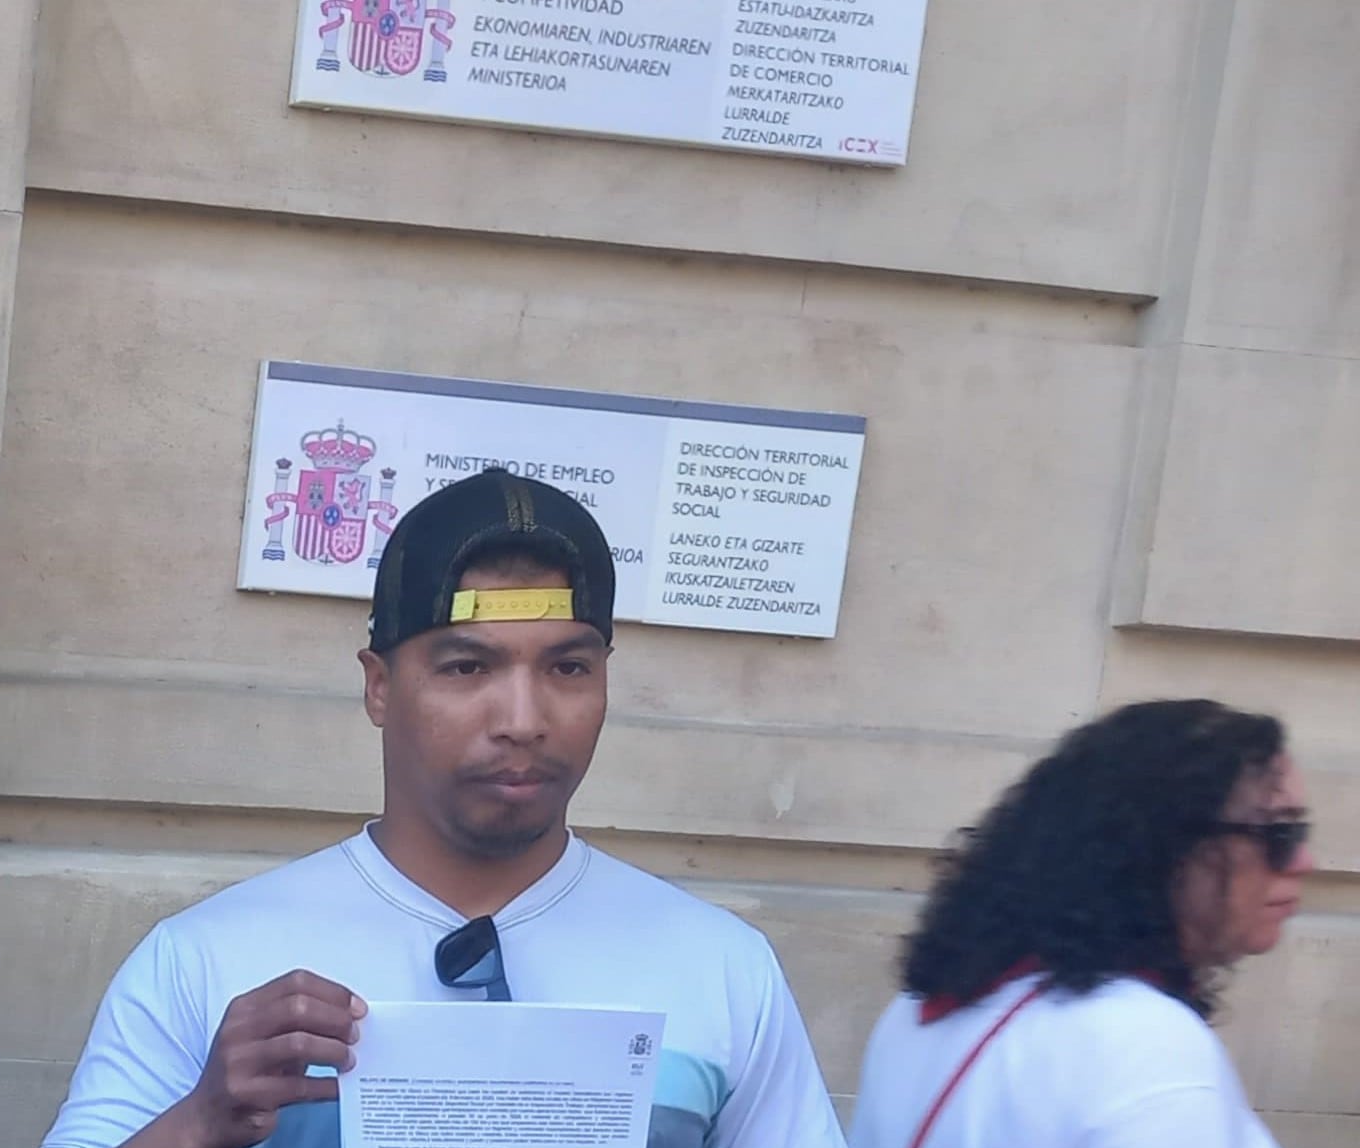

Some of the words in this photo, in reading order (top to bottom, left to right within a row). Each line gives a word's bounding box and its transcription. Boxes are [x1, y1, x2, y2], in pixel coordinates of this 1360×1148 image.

[473, 15, 593, 45] EKONOMIAREN,
[598, 29, 712, 56] INDUSTRIAREN
[735, 19, 836, 43] ZUZENDARITZA
[470, 41, 498, 58] ETA
[503, 45, 672, 77] LEHIAKORTASUNAREN
[732, 42, 815, 64] DIRECCIÓN
[820, 52, 910, 75] TERRITORIAL
[467, 68, 567, 91] MINISTERIOA
[730, 64, 749, 78] DE
[754, 66, 833, 88] COMERCIO
[727, 85, 844, 110] MERKATARITZAKO
[724, 106, 790, 125] LURRALDE
[721, 126, 823, 149] ZUZENDARITZA
[680, 442, 759, 461] DIRECCIÓN
[764, 449, 849, 469] TERRITORIAL
[524, 462, 545, 479] DE
[552, 465, 615, 485] EMPLEO
[677, 462, 696, 476] DE
[700, 464, 784, 483] INSPECCIÓN
[788, 472, 807, 486] DE
[676, 482, 736, 501] TRABAJO
[741, 488, 750, 500] Y
[752, 489, 831, 508] SEGURIDAD
[672, 502, 720, 518] SOCIAL
[670, 532, 721, 548] LANEKO
[724, 536, 747, 550] ETA
[752, 539, 805, 555] GIZARTE
[667, 552, 769, 572] SEGURANTZAKO
[665, 571, 796, 594] IKUSKATZAILETZAREN
[662, 592, 724, 608] LURRALDE
[726, 596, 821, 616] ZUZENDARITZA
